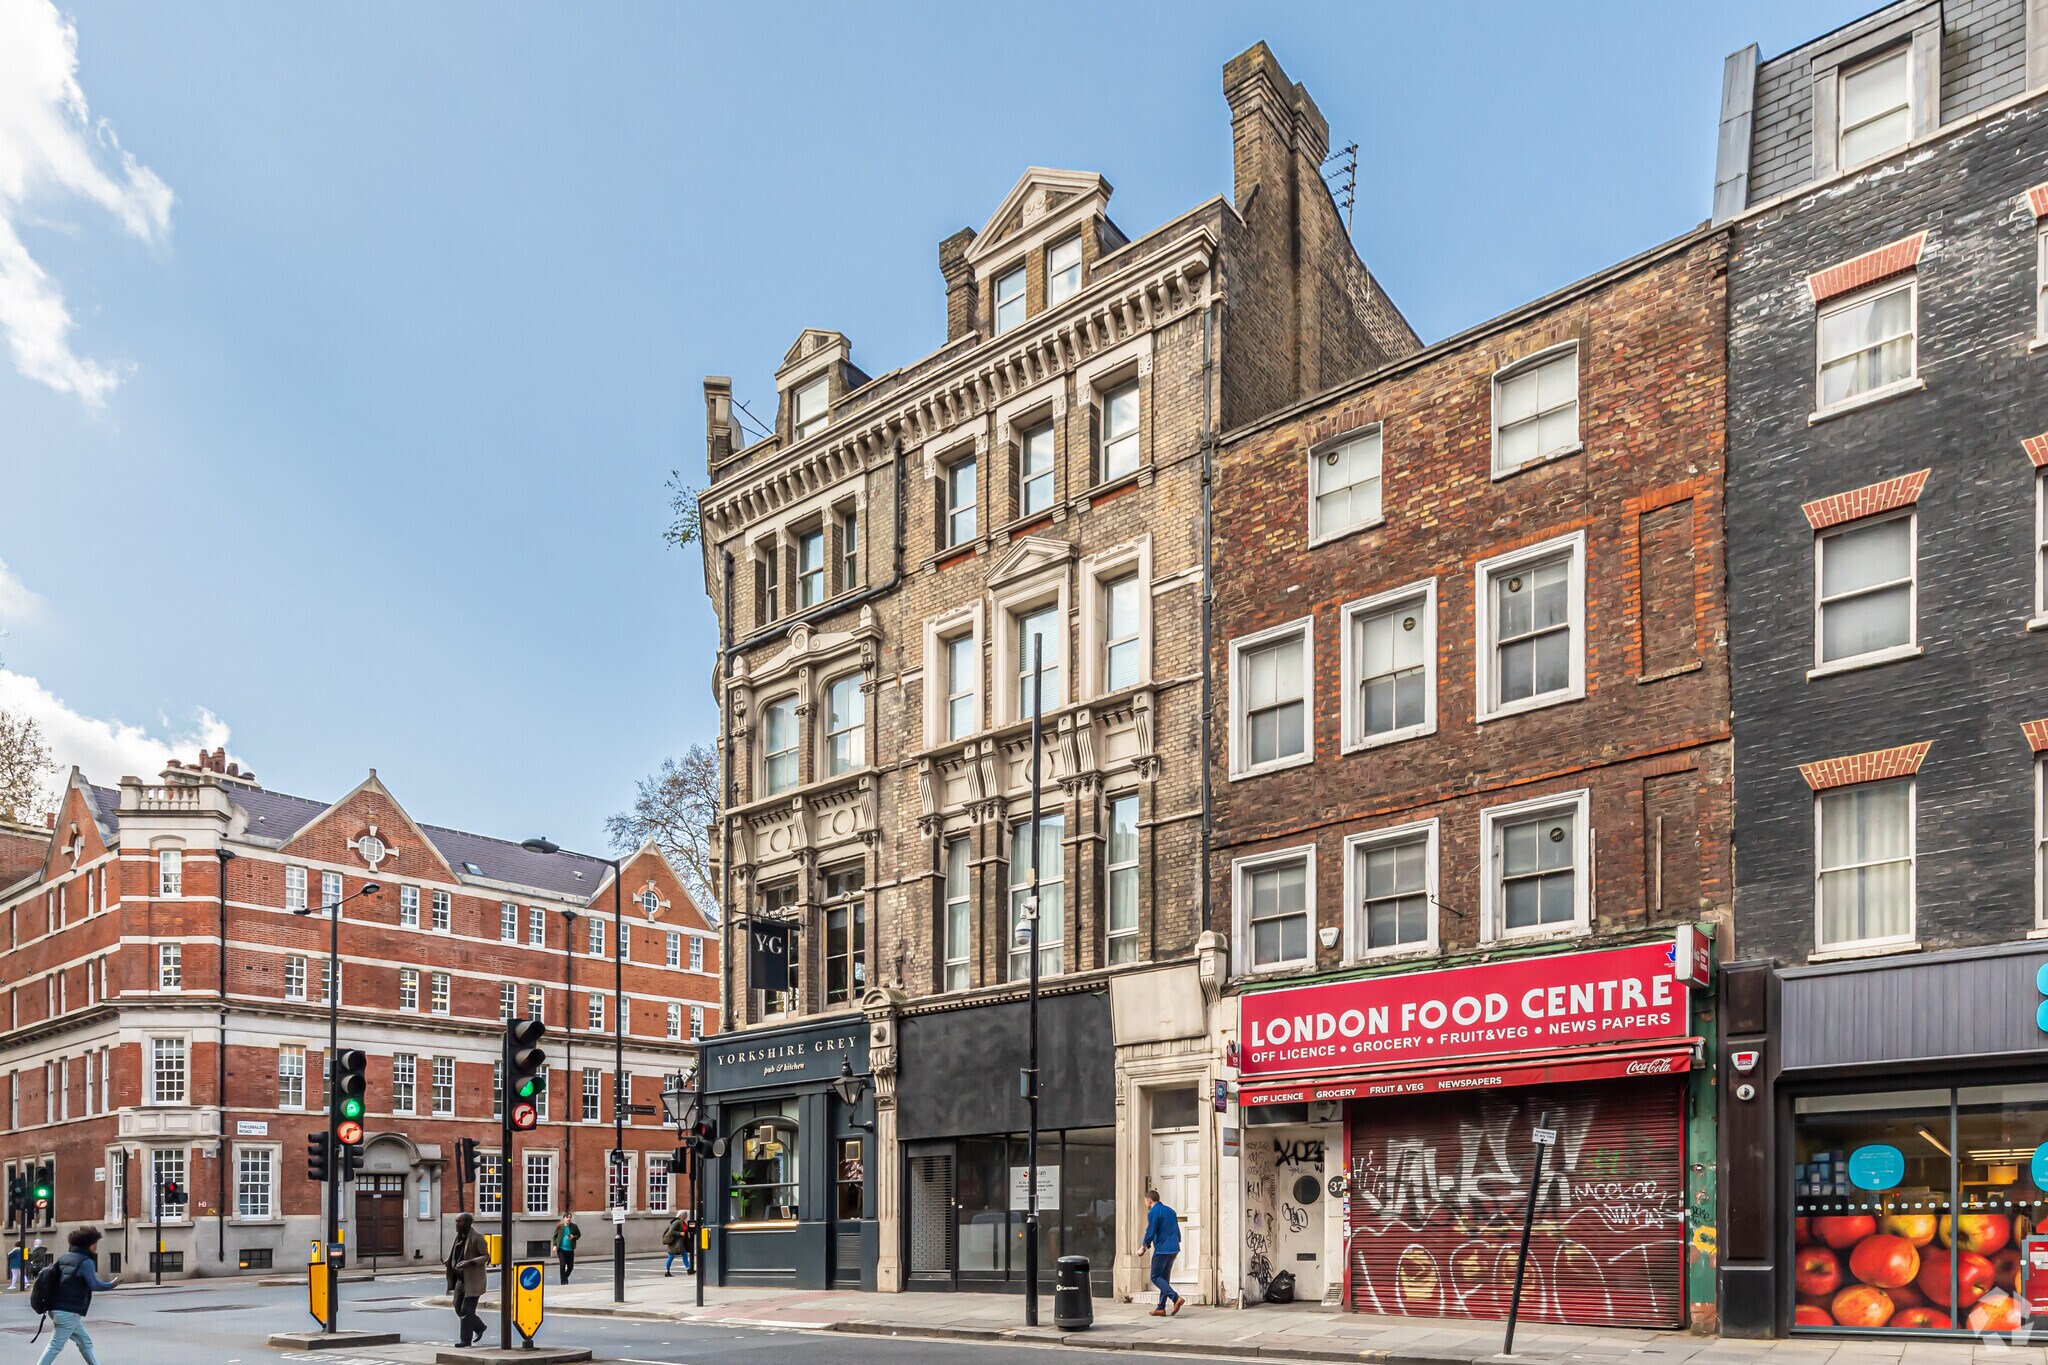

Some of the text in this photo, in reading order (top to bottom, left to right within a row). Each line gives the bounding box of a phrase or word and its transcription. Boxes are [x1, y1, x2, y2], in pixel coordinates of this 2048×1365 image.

[1251, 974, 1673, 1047] LONDON FOOD CENTRE
[717, 1036, 856, 1066] YORKSHIRE GREY
[1251, 1051, 1276, 1063] OFF
[1279, 1045, 1336, 1061] LICENCE
[1353, 1036, 1422, 1053] GROCERY
[1440, 1026, 1528, 1045] FRUIT&VEG
[1549, 1019, 1597, 1035] NEWS
[1602, 1012, 1671, 1030] PAPERS
[763, 1062, 805, 1076] pub & kitchen
[1252, 1076, 1502, 1103] OFF LICENCE GROCERY FRUIT & VEG NEWSPAPERS
